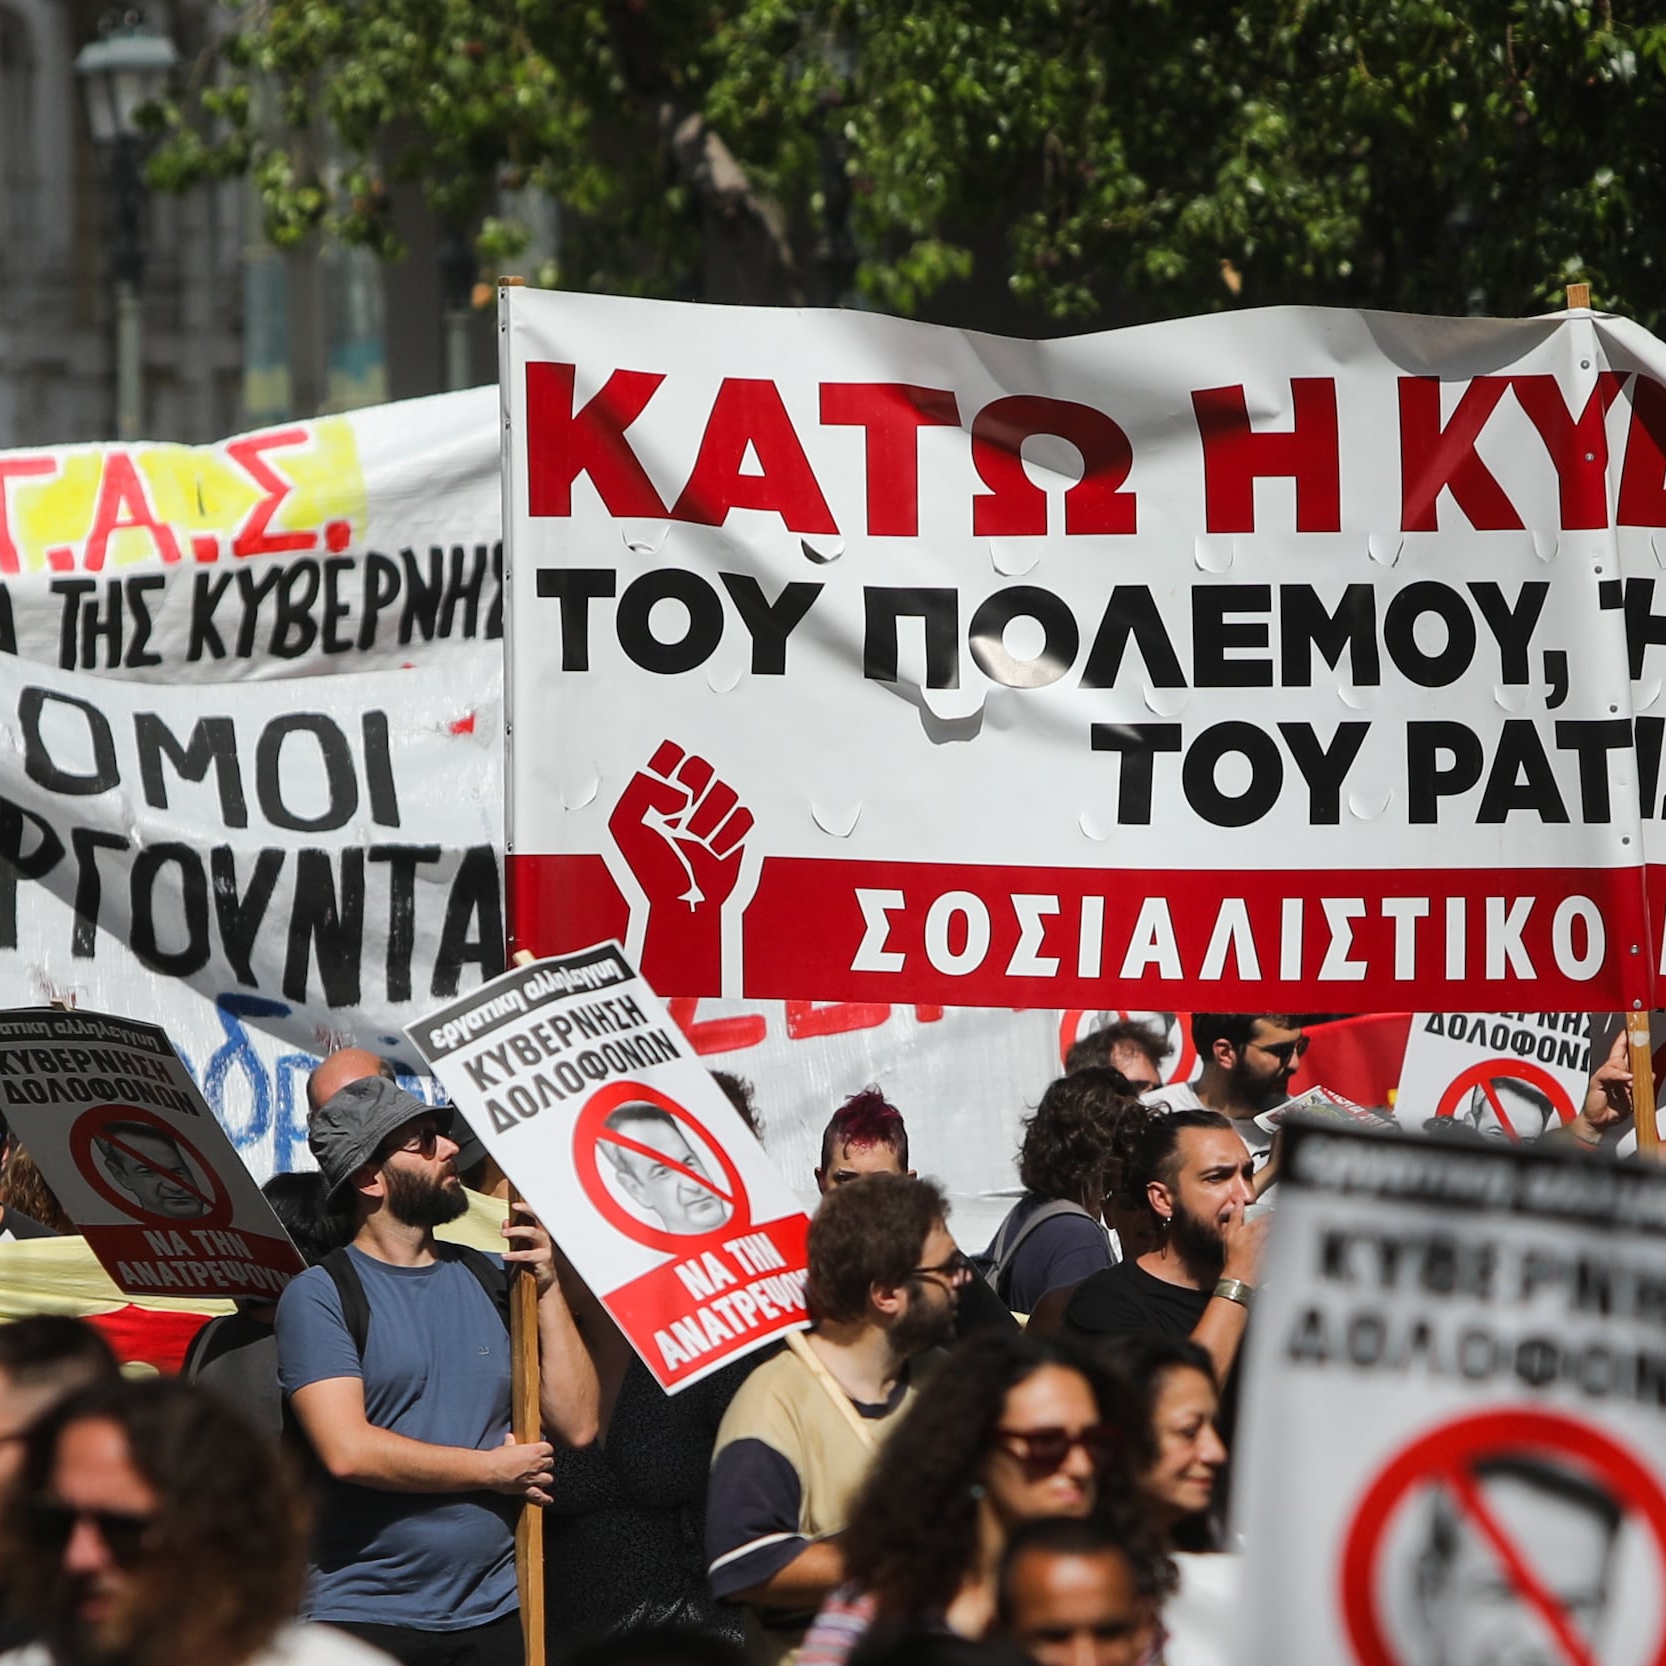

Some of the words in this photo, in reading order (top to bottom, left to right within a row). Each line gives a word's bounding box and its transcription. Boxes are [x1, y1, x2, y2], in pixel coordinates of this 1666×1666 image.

[525, 360, 1138, 538] ΚΑΤΩ
[1190, 376, 1342, 534] Η
[49, 574, 165, 671] ΤΗΣ
[536, 566, 825, 676] ΤΟΥ
[863, 579, 1569, 710] ΠΟΛΕΜΟΥ,
[1090, 722, 1372, 826] ΤΟΥ
[850, 886, 1607, 983] ΣΟΣΙΑΛΙΣΤΙΚΟ
[430, 990, 528, 1050] εργατικη
[524, 958, 626, 1007] αλληλεγγυη
[461, 993, 649, 1093] ΚΥΒΕΡΝΗΣΗ
[2, 1077, 201, 1117] ΔΟΛΟΦΟΝΩΝ
[482, 1026, 681, 1136] ΔΟΛΟΦΟΝΩΝ
[116, 1261, 293, 1293] ΑΝΑΤΡΕΨΟΥΜ
[142, 1230, 196, 1257] ΝΑ
[191, 1230, 254, 1260] ΤΗΝ
[672, 1252, 731, 1302] ΝΑ
[721, 1231, 788, 1282] ΤΗΝ
[652, 1270, 809, 1373] ΑΝΑΤΡΕΨΟΥ
